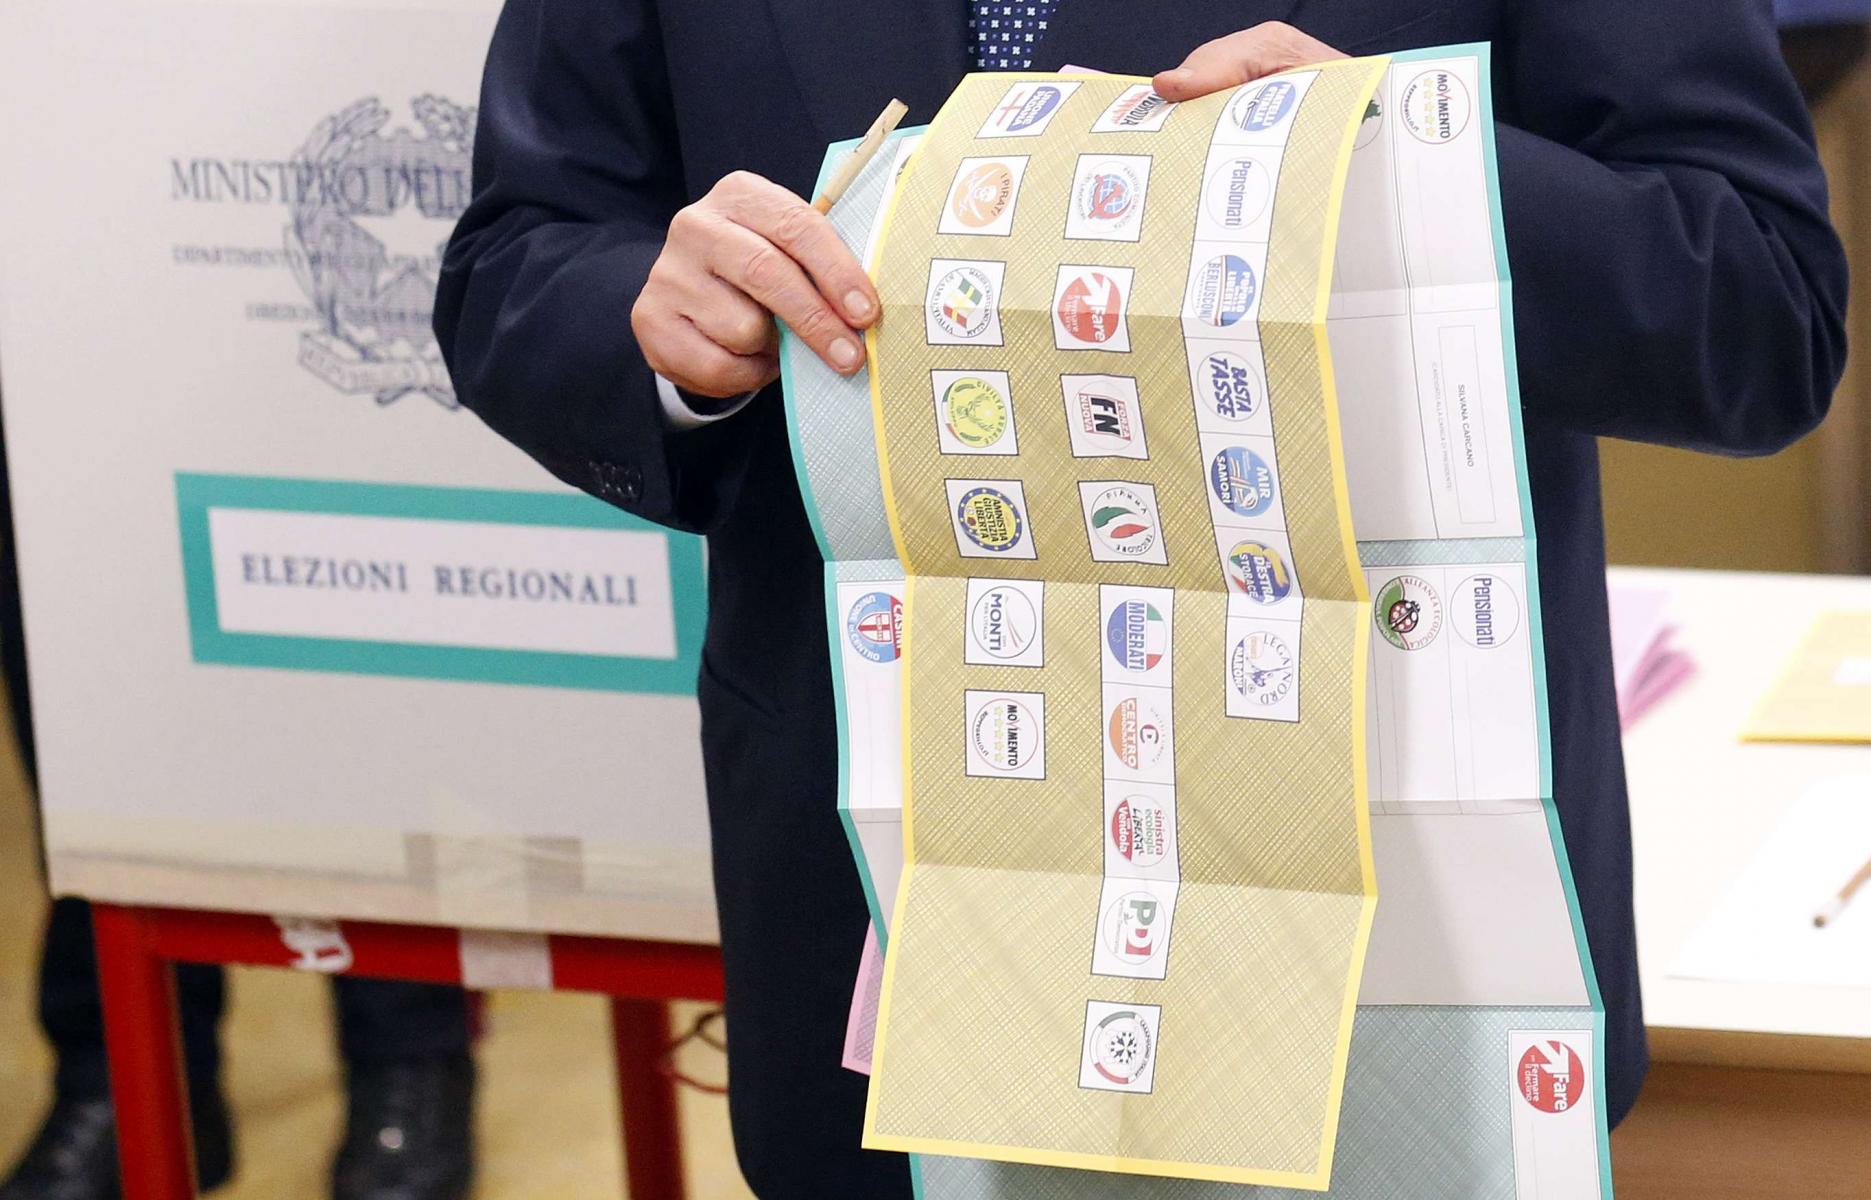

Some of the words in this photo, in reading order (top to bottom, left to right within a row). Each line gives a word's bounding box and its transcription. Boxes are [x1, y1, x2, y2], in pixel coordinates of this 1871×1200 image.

[1120, 93, 1162, 125] NGROIA
[1225, 160, 1252, 226] Pensionati
[1198, 263, 1222, 320] BERLUSCONI
[1090, 306, 1106, 342] Fare
[1210, 357, 1236, 418] TASSE
[1231, 367, 1252, 412] BASTA
[1458, 384, 1468, 420] SILVANA
[1080, 394, 1094, 432] NUOVA
[1091, 397, 1120, 436] FN
[1462, 422, 1474, 468] CARCANO
[1256, 466, 1270, 498] MIR
[982, 498, 1001, 542] GIUSTIZIA
[992, 499, 1008, 542] AMNISTIA
[241, 552, 408, 593] ELEZIONI
[434, 564, 638, 606] REGIONALI
[1240, 554, 1258, 600] STORACE
[1253, 556, 1275, 601] DESTRA
[990, 594, 1002, 650] MONTI
[1474, 578, 1496, 645] Pensionati
[1128, 602, 1145, 670] MODERATI
[1264, 634, 1291, 666] LEGA
[1233, 648, 1244, 687] MARONI
[1260, 674, 1292, 705] NORD
[1006, 704, 1020, 766] MOVIMENTO
[1126, 700, 1136, 768] CENTRO
[1118, 806, 1130, 852] Vendola
[1145, 808, 1156, 855] ecologia
[1154, 810, 1165, 856] sinistra
[1126, 900, 1157, 956] PD
[1530, 1063, 1540, 1102] Fermare
[1552, 1074, 1570, 1110] Fare
